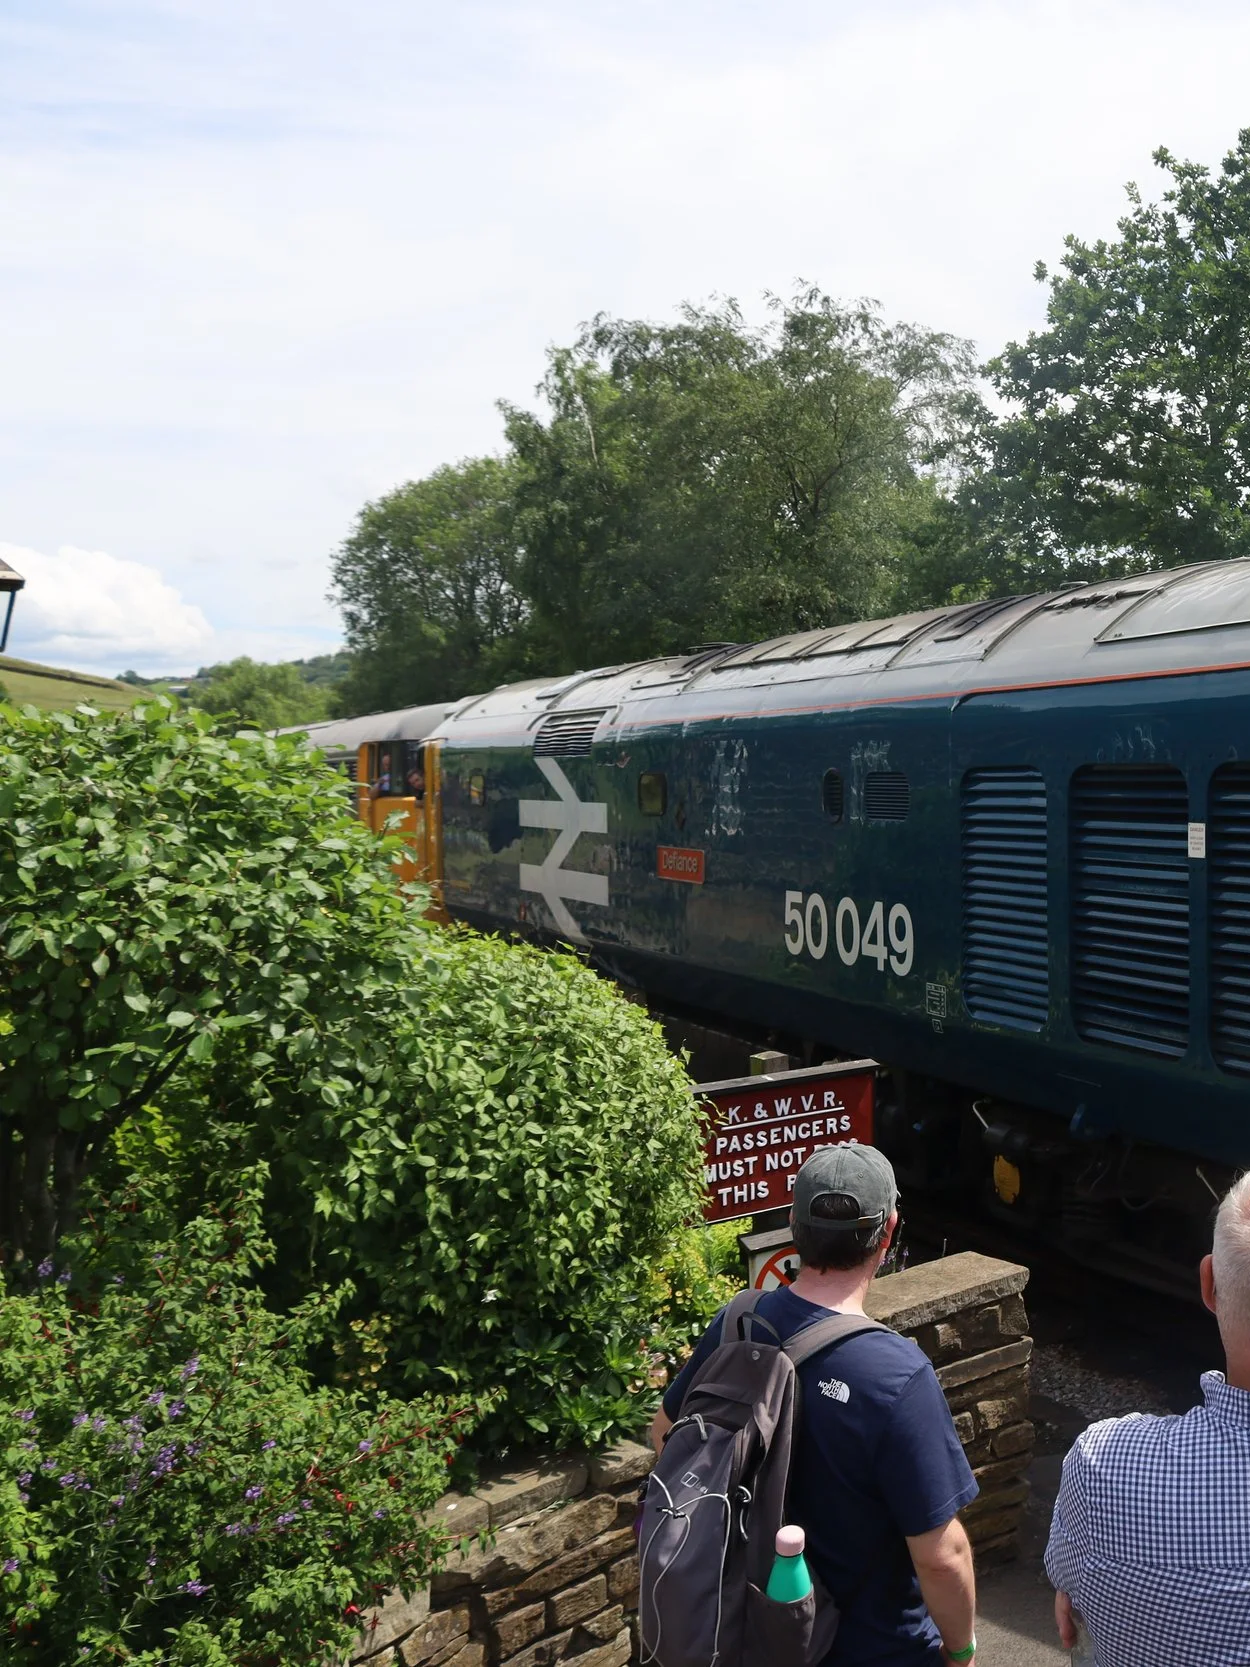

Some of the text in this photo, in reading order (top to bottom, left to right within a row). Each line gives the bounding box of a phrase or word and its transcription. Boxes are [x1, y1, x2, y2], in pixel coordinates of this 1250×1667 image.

[663, 850, 698, 873] Defiance
[784, 889, 914, 976] 50 049
[728, 1091, 843, 1125] K. & W. V. R.
[716, 1115, 851, 1155] PASSENGERS
[703, 1156, 758, 1184] MUST
[765, 1147, 807, 1171] NOT
[717, 1180, 769, 1206] THIS
[818, 1380, 840, 1394] NORTH
[821, 1388, 837, 1399] FACE
[830, 1378, 842, 1387] THE
